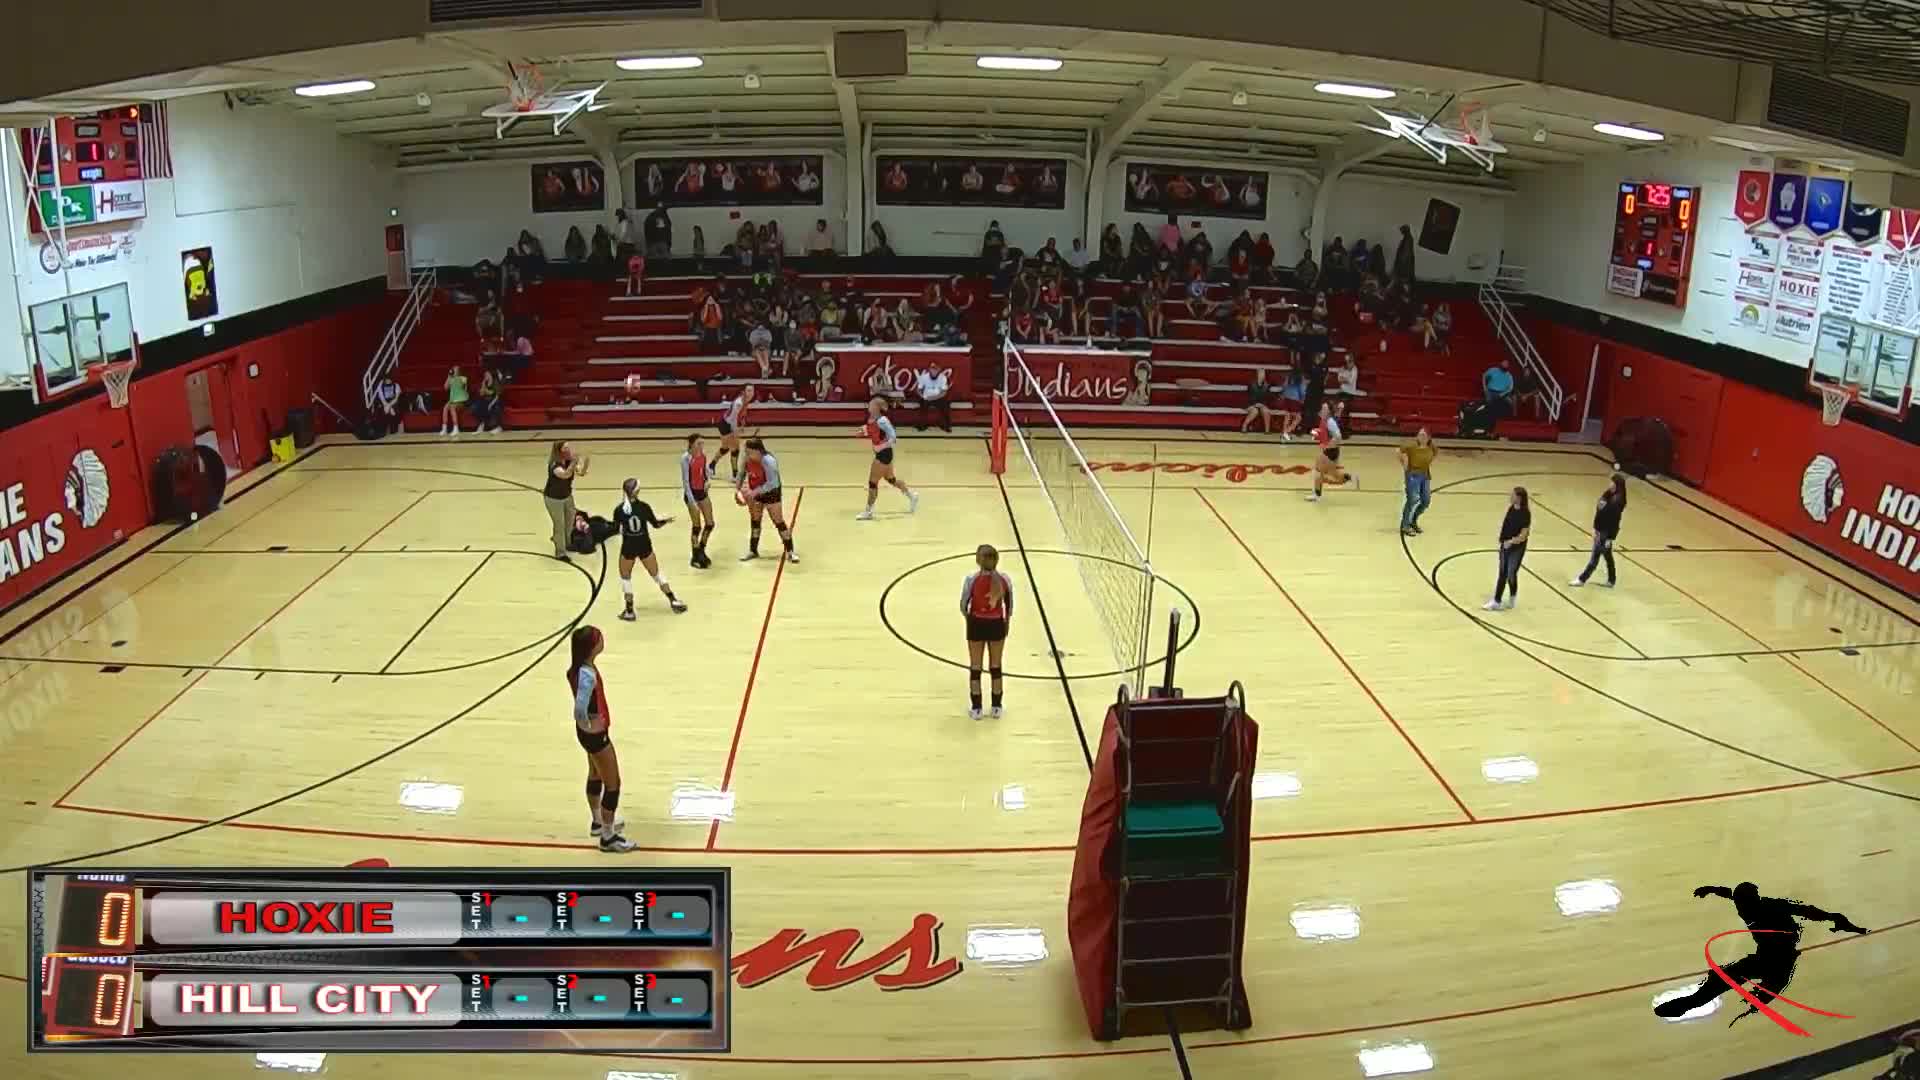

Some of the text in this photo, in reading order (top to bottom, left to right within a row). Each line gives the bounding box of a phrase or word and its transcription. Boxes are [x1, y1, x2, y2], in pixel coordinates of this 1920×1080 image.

[1625, 194, 1635, 214] 0
[1679, 199, 1691, 220] 0
[1778, 279, 1819, 298] HOXIE
[1877, 484, 1920, 531] HO
[629, 515, 641, 533] 0
